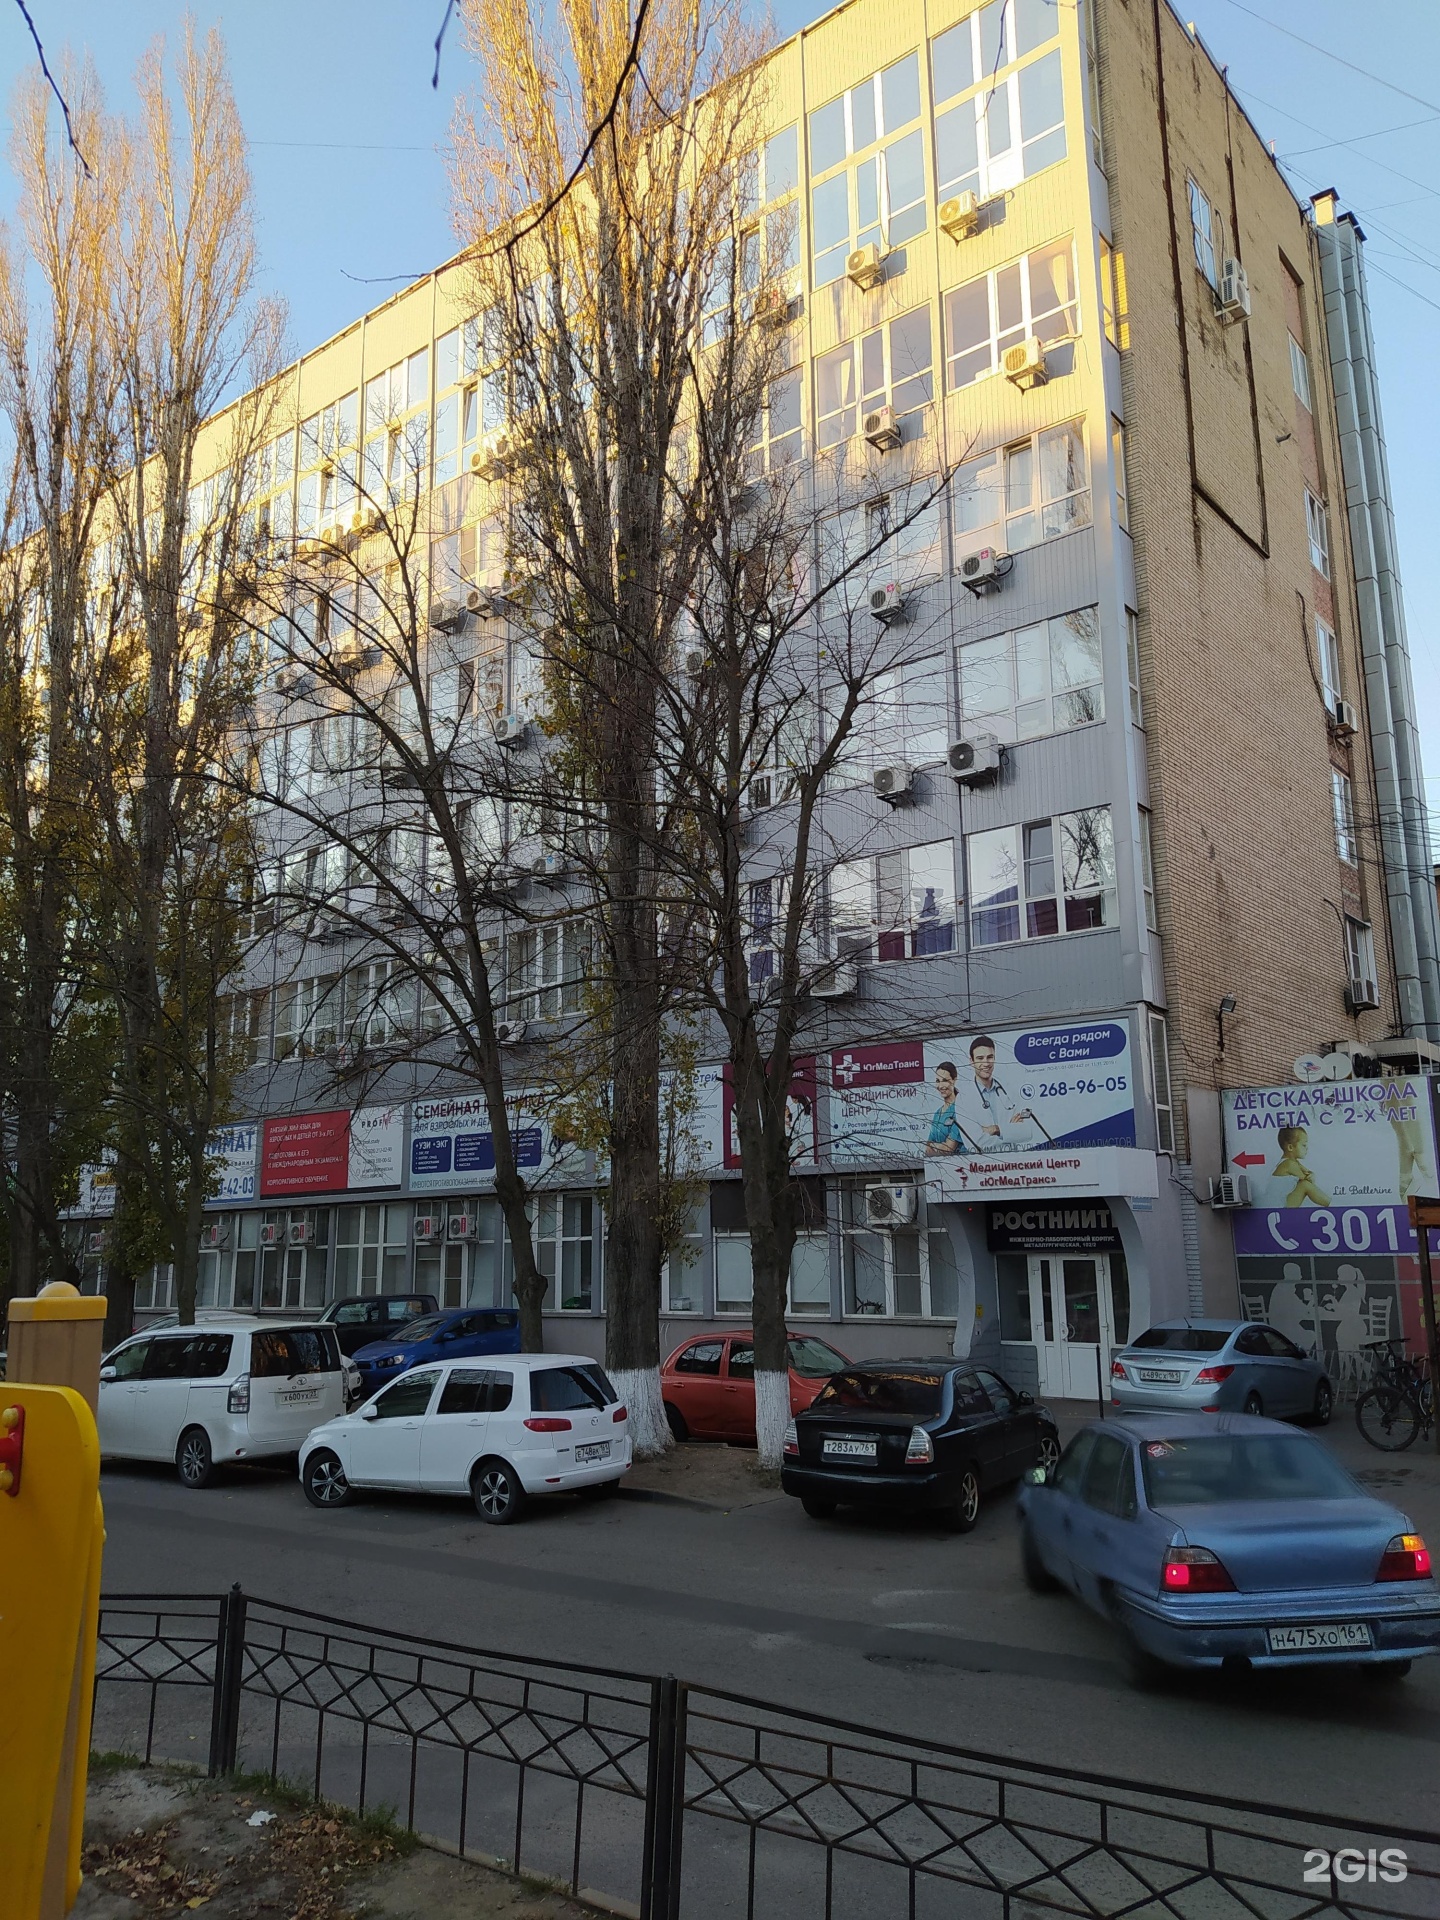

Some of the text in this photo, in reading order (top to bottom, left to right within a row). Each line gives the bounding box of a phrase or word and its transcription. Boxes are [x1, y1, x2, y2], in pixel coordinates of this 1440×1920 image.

[1028, 1030, 1111, 1048] Всегда рядом
[1049, 1047, 1090, 1059] с Вами
[863, 1060, 920, 1072] ЮгМедТранс
[1039, 1076, 1127, 1098] 268-96-05
[841, 1088, 917, 1103] МЕДИЦИНСКИЙ
[1233, 1082, 1418, 1110] ДЕТСКАЯ ШКОЛА
[415, 1098, 480, 1120] СЕМЕЙНАЯ
[841, 1106, 871, 1118] ЦЕНТР
[1236, 1110, 1310, 1130] БАЛЕТА
[1387, 1106, 1417, 1122] ЛЕТ
[430, 1119, 468, 1131] ВЗРОСЛЫХ
[419, 1140, 448, 1150] УЗИ ЭКГ
[969, 1157, 1081, 1173] Медицинский Центр
[980, 1174, 1056, 1187] «ЮгМедТранс»
[284, 1392, 309, 1402] Х600УХ
[577, 1446, 600, 1458] Е748ВК
[827, 1442, 875, 1453] Т283АУ 761
[1275, 1625, 1364, 1647] Н475ХО 161
